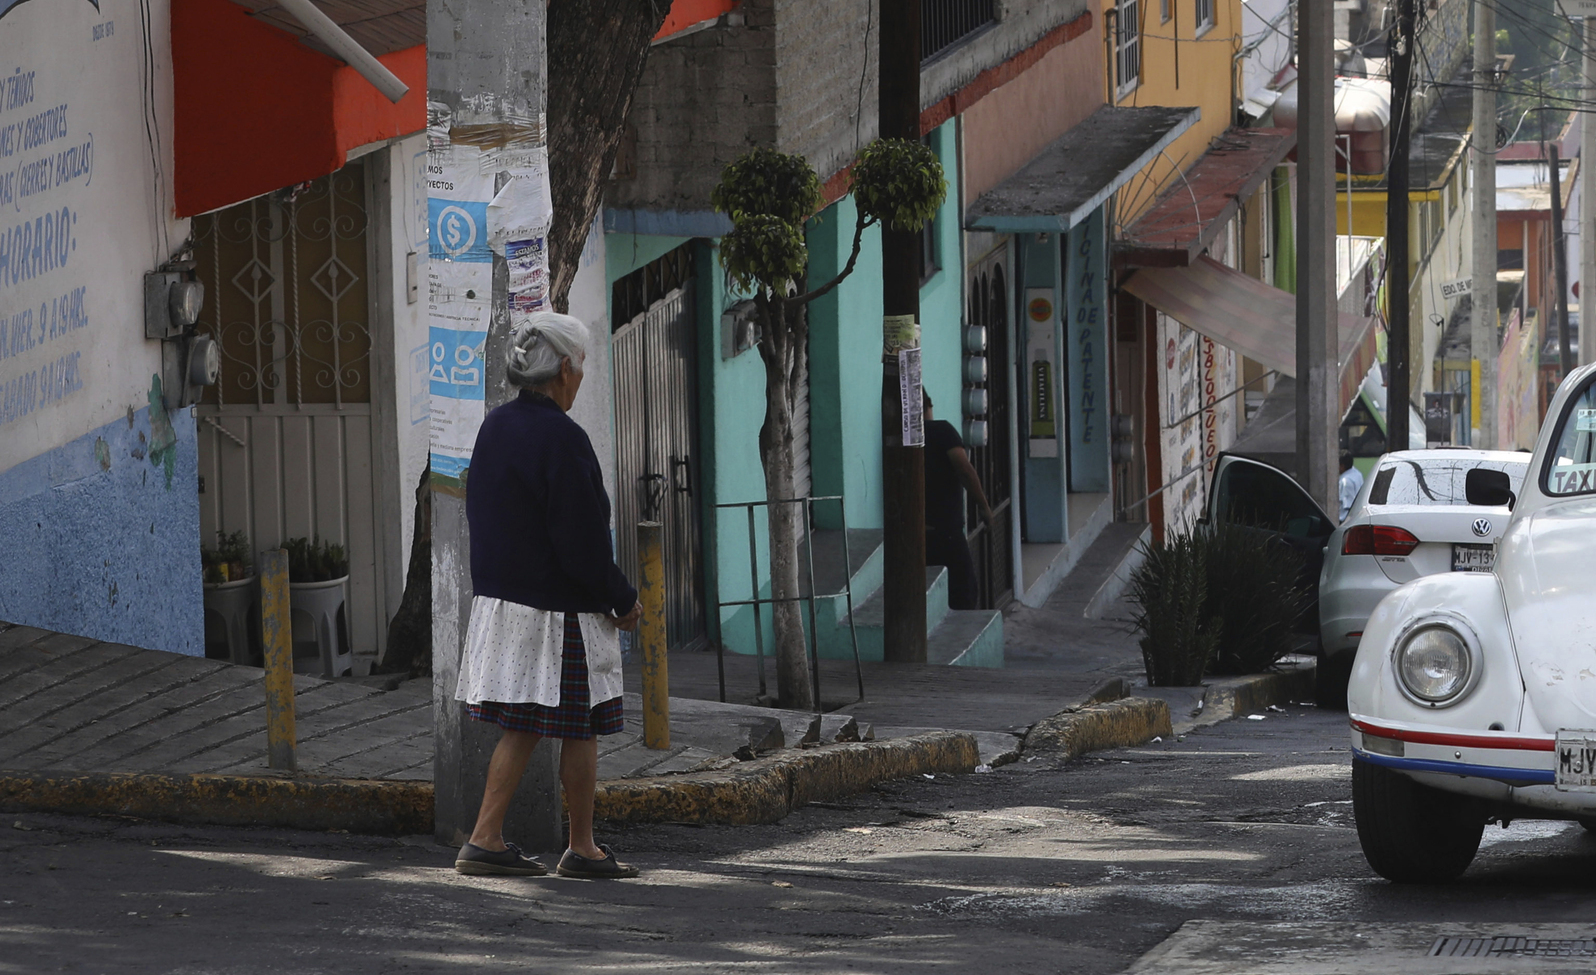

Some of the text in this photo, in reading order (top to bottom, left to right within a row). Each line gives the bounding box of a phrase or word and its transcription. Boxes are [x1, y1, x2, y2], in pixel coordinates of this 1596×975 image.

[16, 120, 24, 153] Y
[1456, 281, 1466, 292] DE
[38, 301, 47, 345] 9
[1079, 329, 1096, 444] PATENTE
